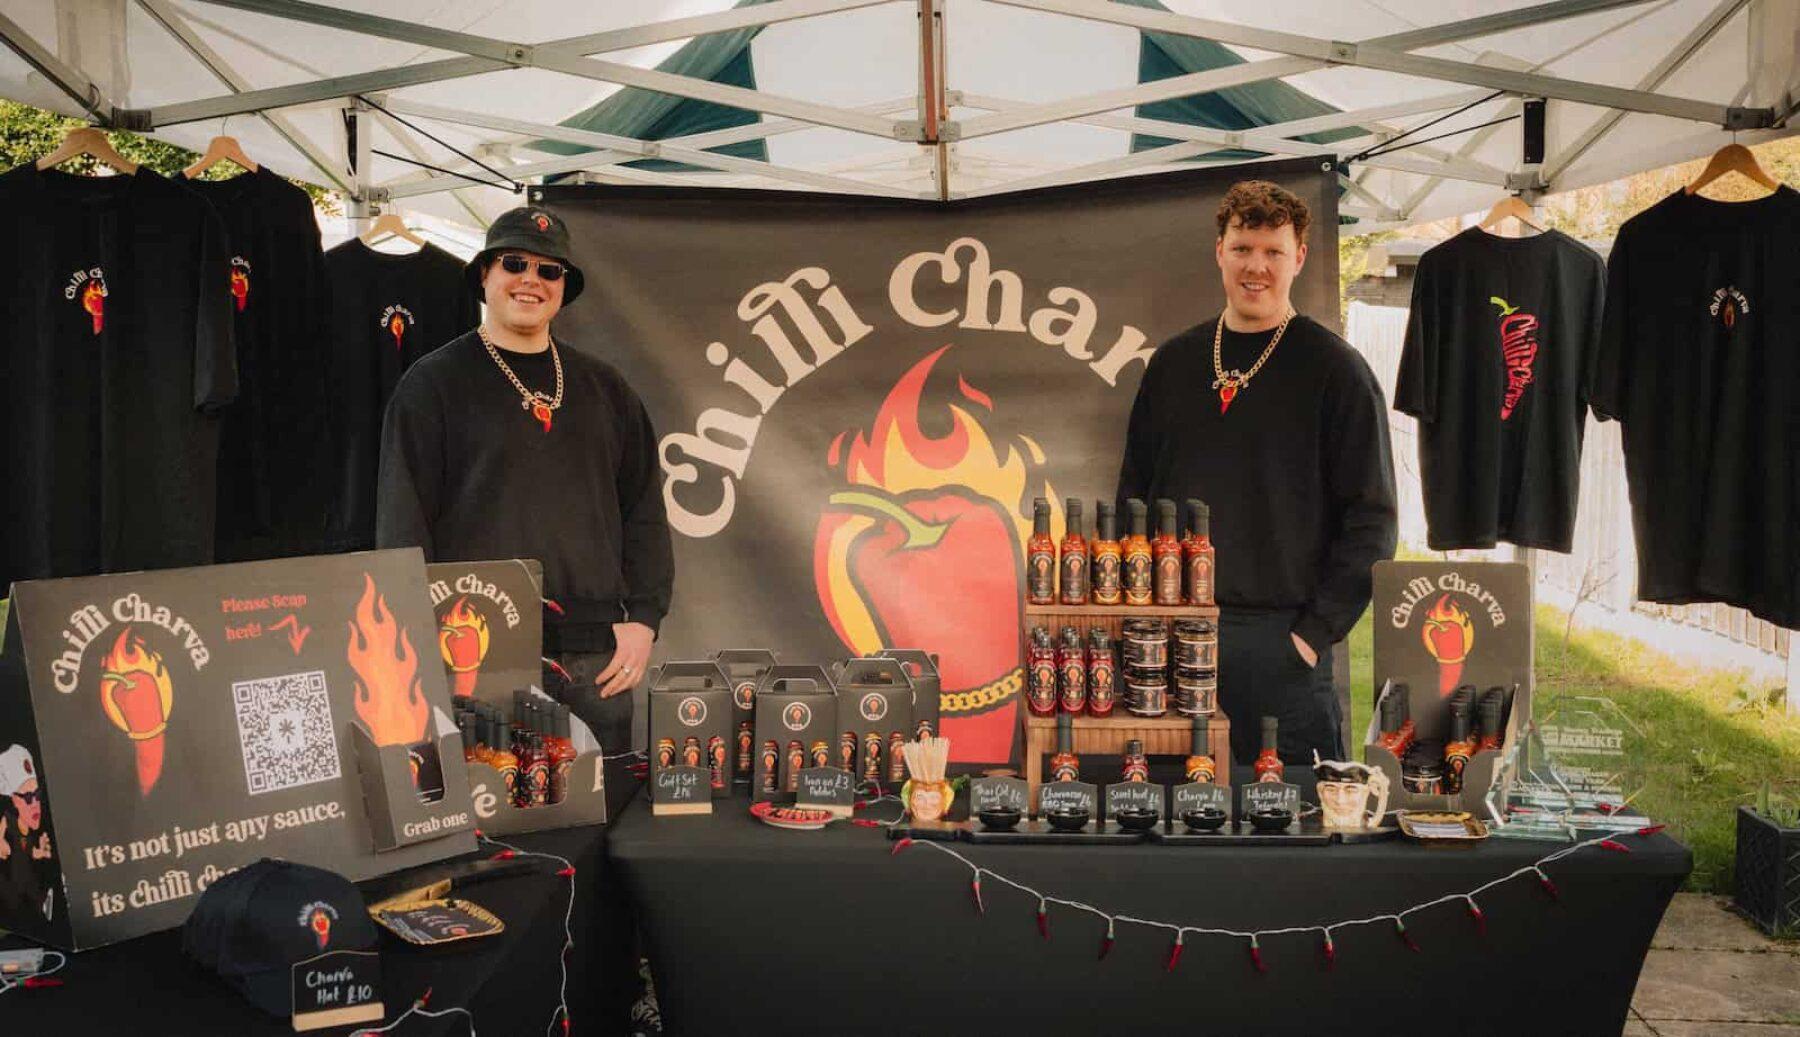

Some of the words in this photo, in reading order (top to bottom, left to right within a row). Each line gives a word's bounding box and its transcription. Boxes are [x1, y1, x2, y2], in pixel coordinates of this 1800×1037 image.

[889, 236, 1157, 387] Char
[222, 597, 270, 613] Please
[84, 844, 125, 870] It's
[130, 833, 171, 860] not
[174, 822, 221, 858] just
[225, 813, 270, 842] any
[274, 801, 346, 829] sauce,
[404, 816, 440, 838] Grab
[442, 812, 469, 828] one
[91, 890, 126, 918] its
[305, 966, 355, 989] Charva
[316, 986, 340, 1005] Hat
[346, 984, 373, 1005] £10
